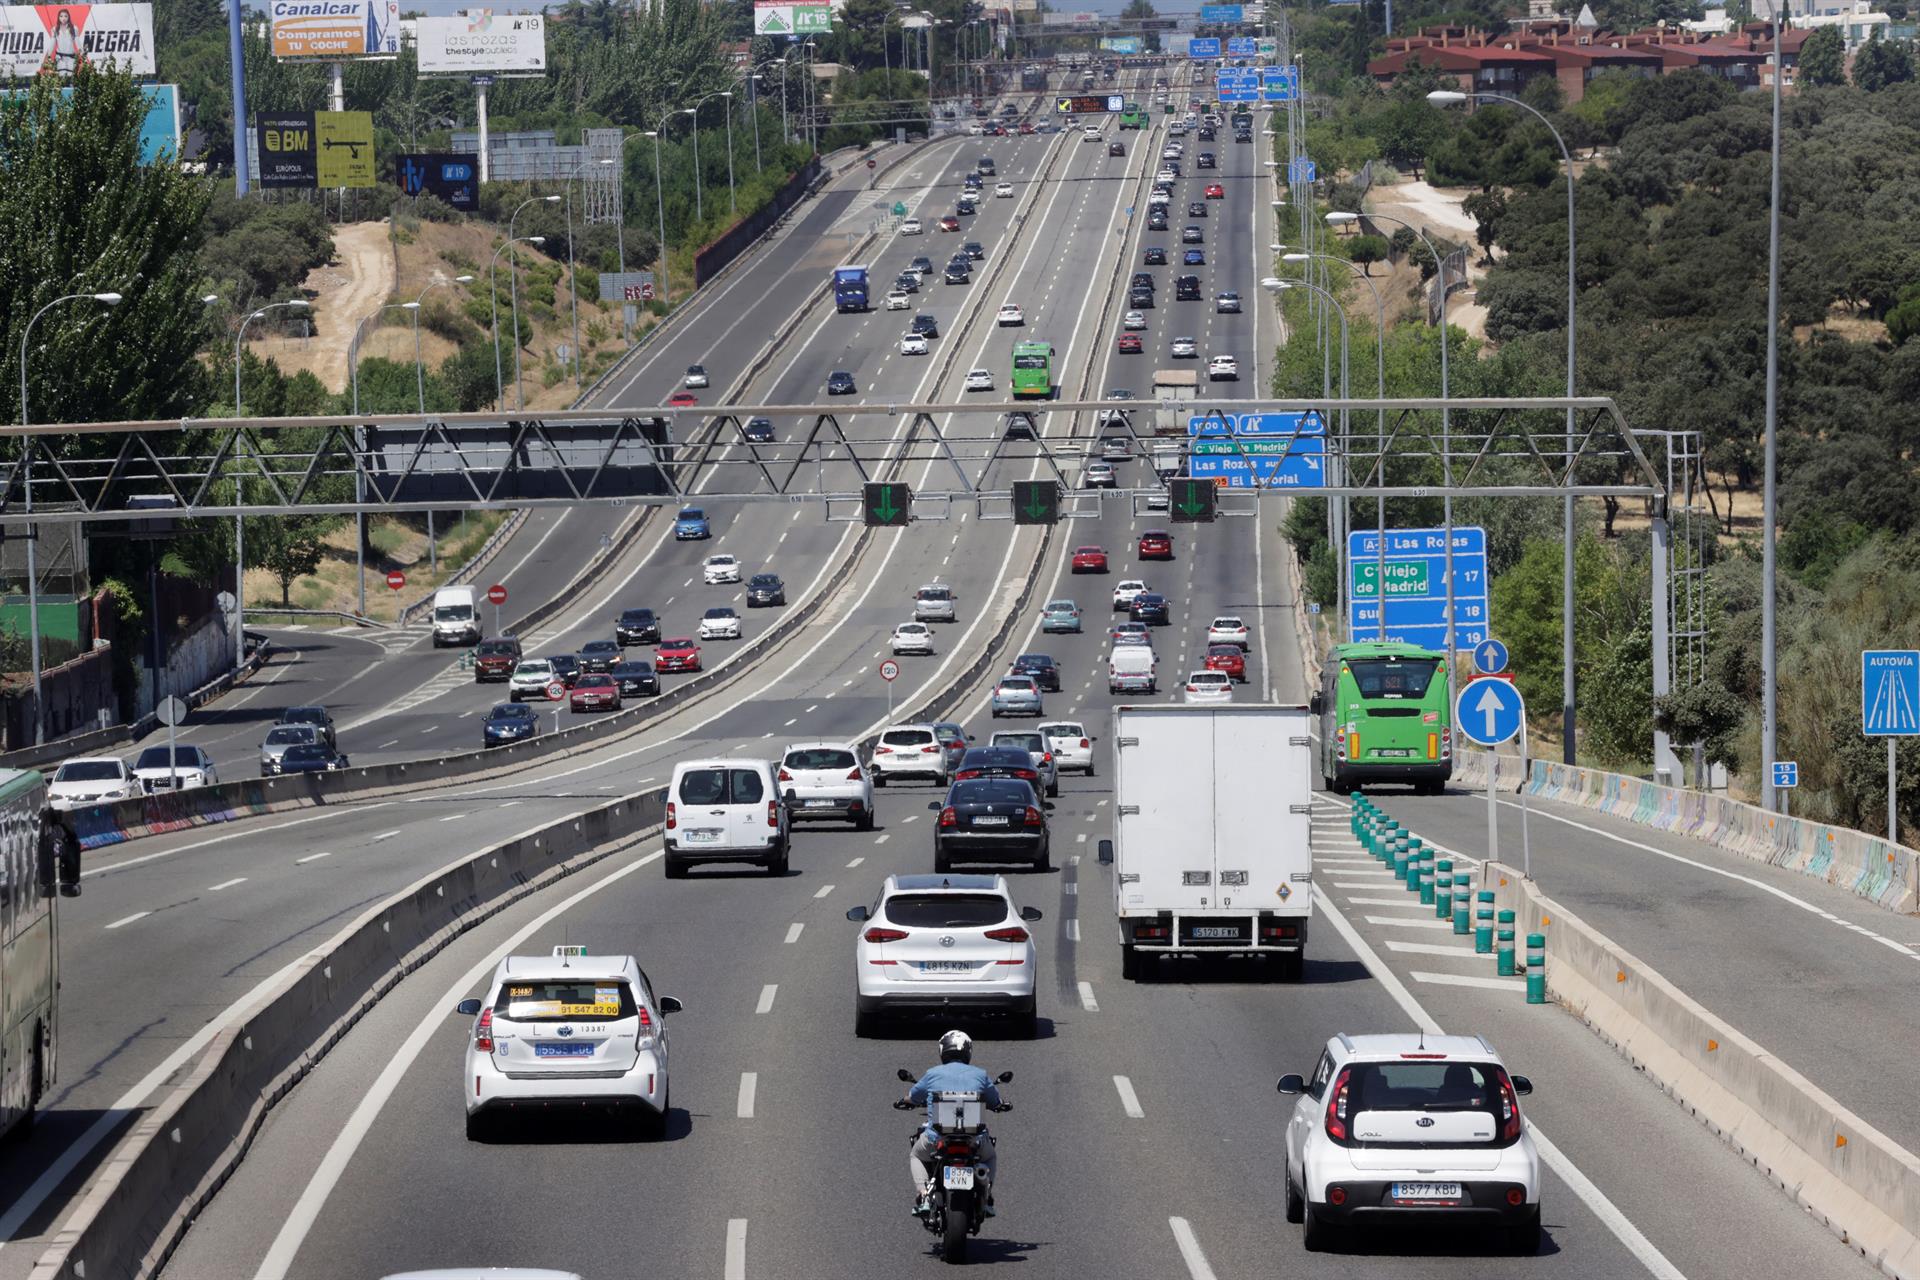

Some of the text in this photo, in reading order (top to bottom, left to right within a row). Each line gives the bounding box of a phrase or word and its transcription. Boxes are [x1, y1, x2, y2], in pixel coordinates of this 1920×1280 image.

[275, 2, 360, 15] Canalcar
[525, 18, 539, 30] 19
[816, 14, 827, 24] 19
[276, 30, 361, 41] Compramos
[445, 35, 518, 45] las rozas
[83, 30, 140, 53] NEGRA
[288, 41, 348, 50] TU COCHE
[386, 40, 397, 52] 18
[282, 130, 309, 152] BM
[455, 167, 465, 178] 19
[1254, 442, 1287, 452] Madrid
[1195, 461, 1216, 470] Las
[1231, 477, 1244, 486] El
[1394, 538, 1418, 549] Las
[1426, 536, 1468, 548] Roas
[1384, 564, 1418, 578] Viejo
[1464, 570, 1479, 582] 17
[1356, 583, 1374, 593] de
[1465, 605, 1480, 617] 18
[1466, 632, 1480, 643] 19
[1870, 655, 1914, 666] AUTOVÍA
[1781, 774, 1789, 785] 2
[574, 1006, 590, 1014] 547
[606, 1006, 618, 1014] 00
[1401, 1184, 1457, 1195] 8577 KBD
